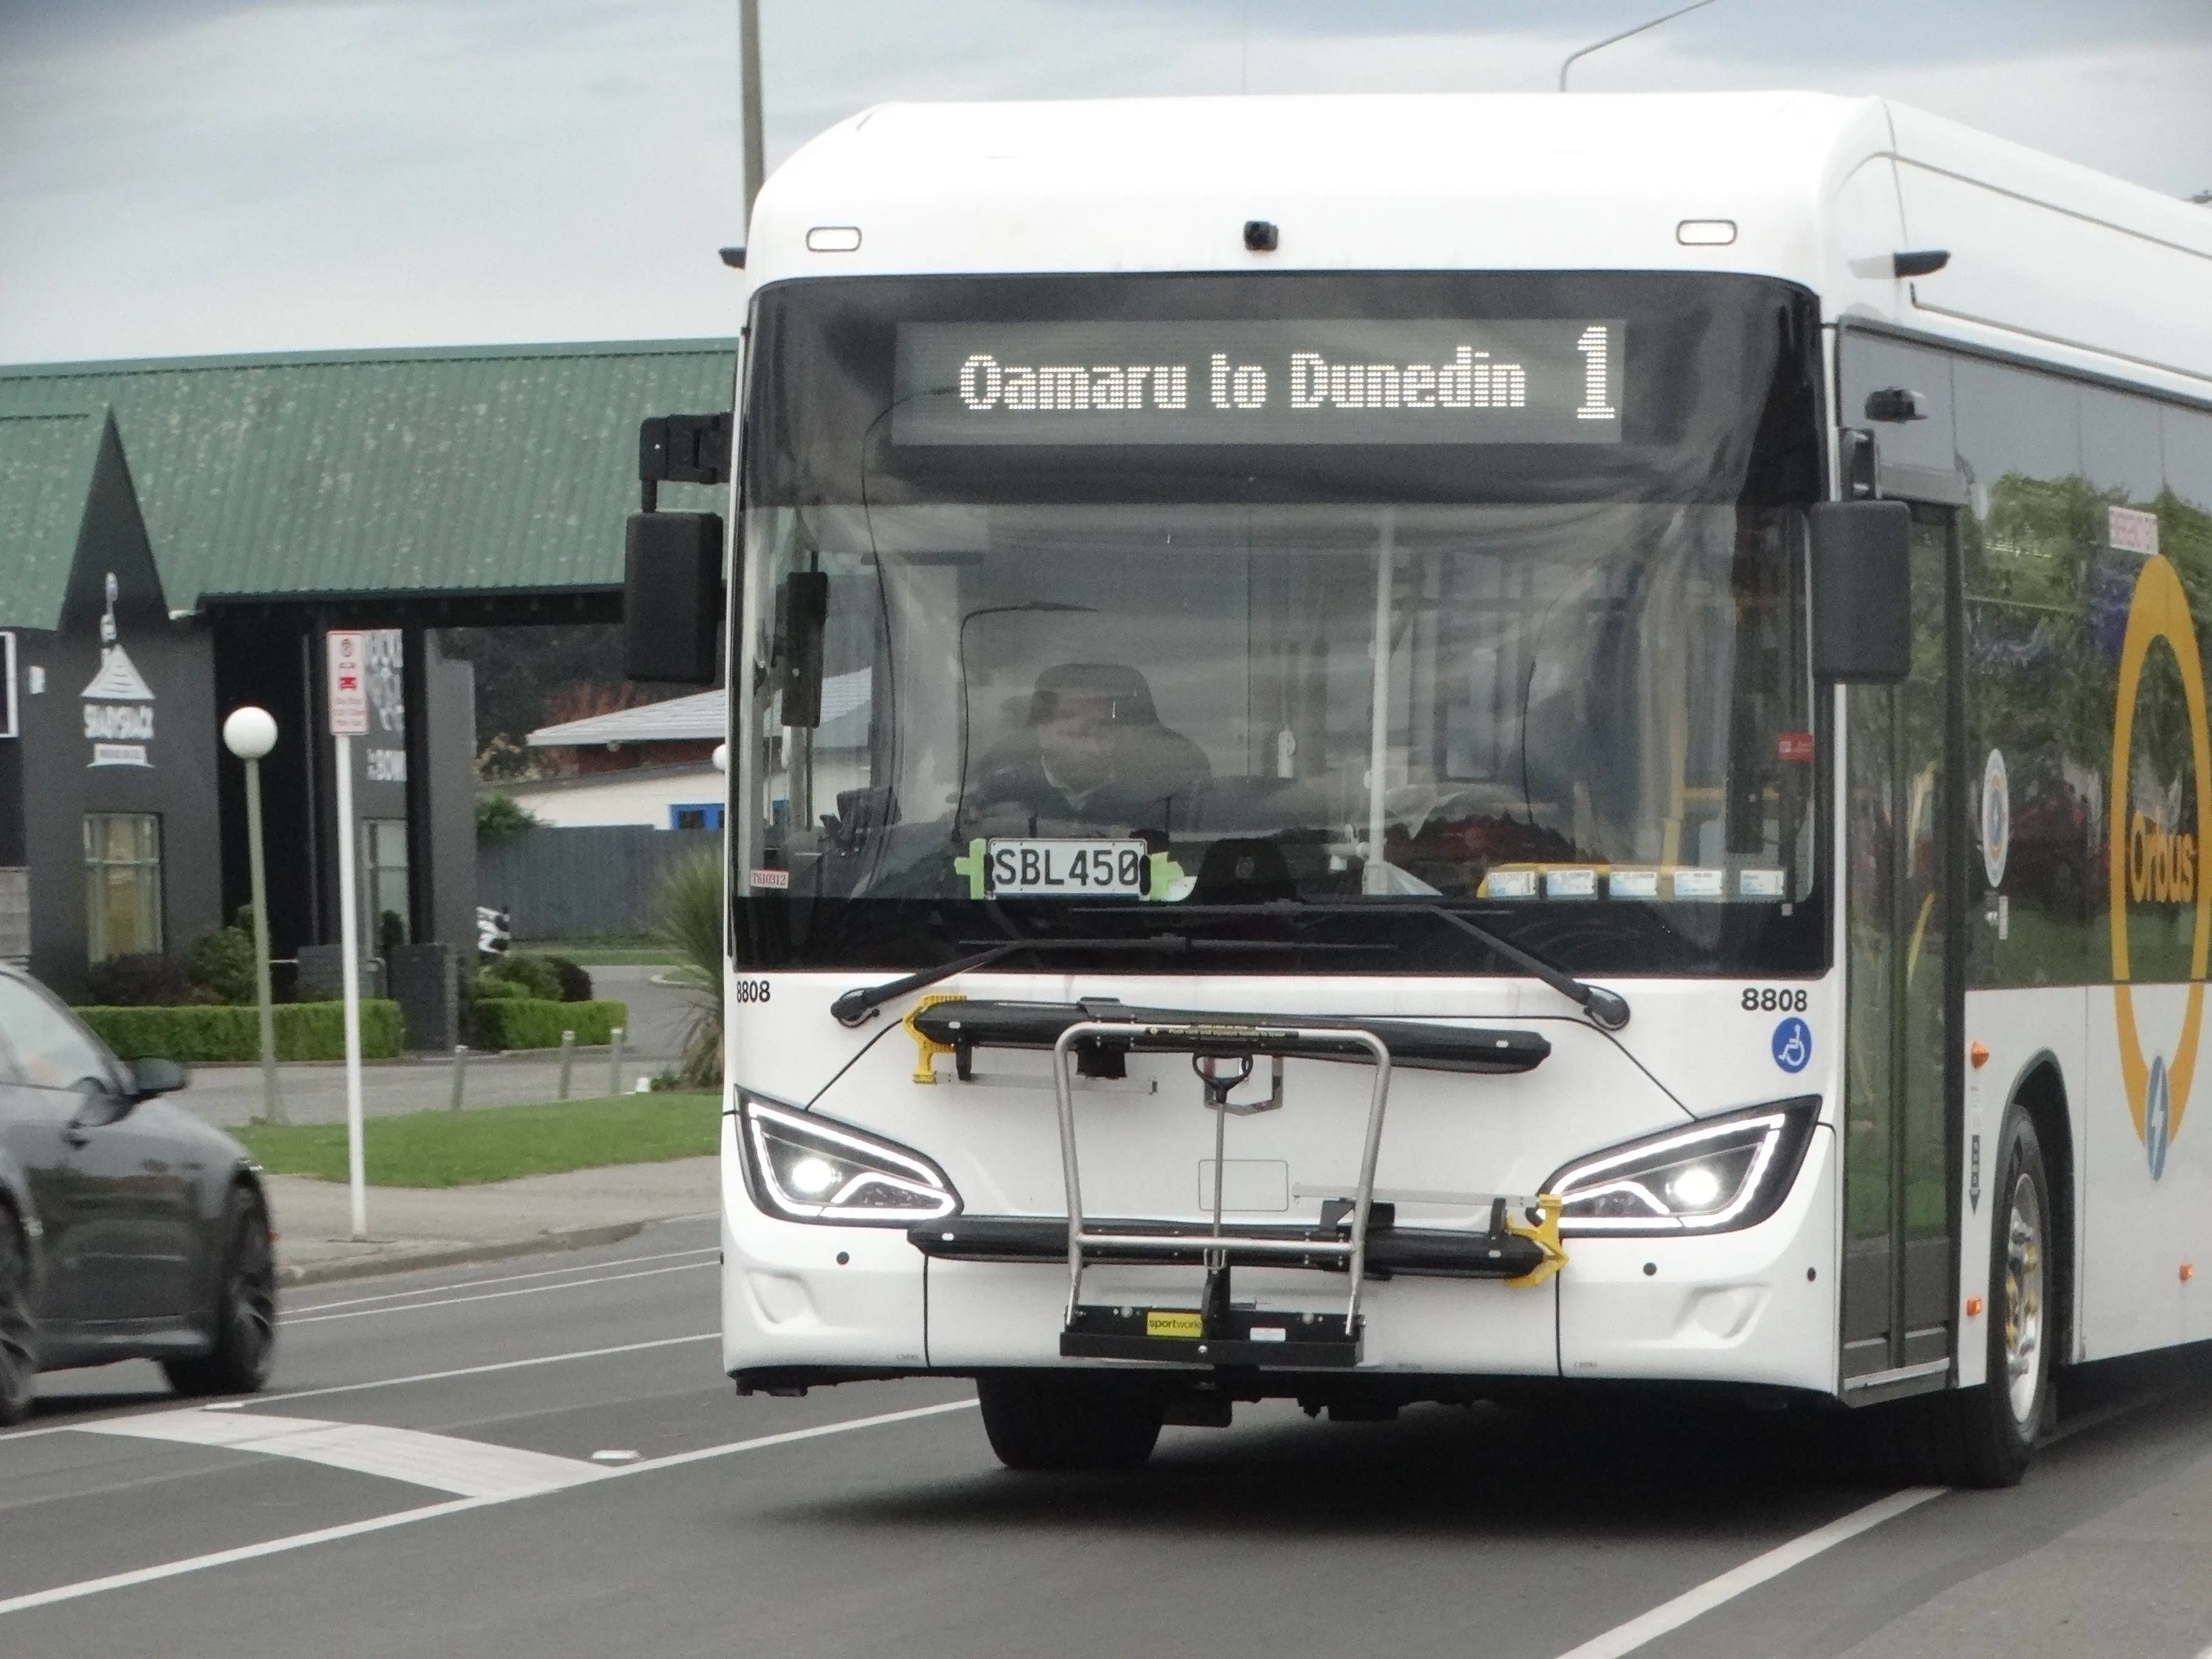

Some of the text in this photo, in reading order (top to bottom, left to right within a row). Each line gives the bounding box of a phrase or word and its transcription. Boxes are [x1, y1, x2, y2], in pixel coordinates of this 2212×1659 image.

[960, 346, 1525, 411] Oamaru to Dunedin
[1577, 326, 1615, 419] 1
[995, 848, 1139, 886] SBL450
[2130, 805, 2194, 903] Orbus
[737, 980, 771, 1003] 8808
[1741, 988, 1808, 1012] 8808
